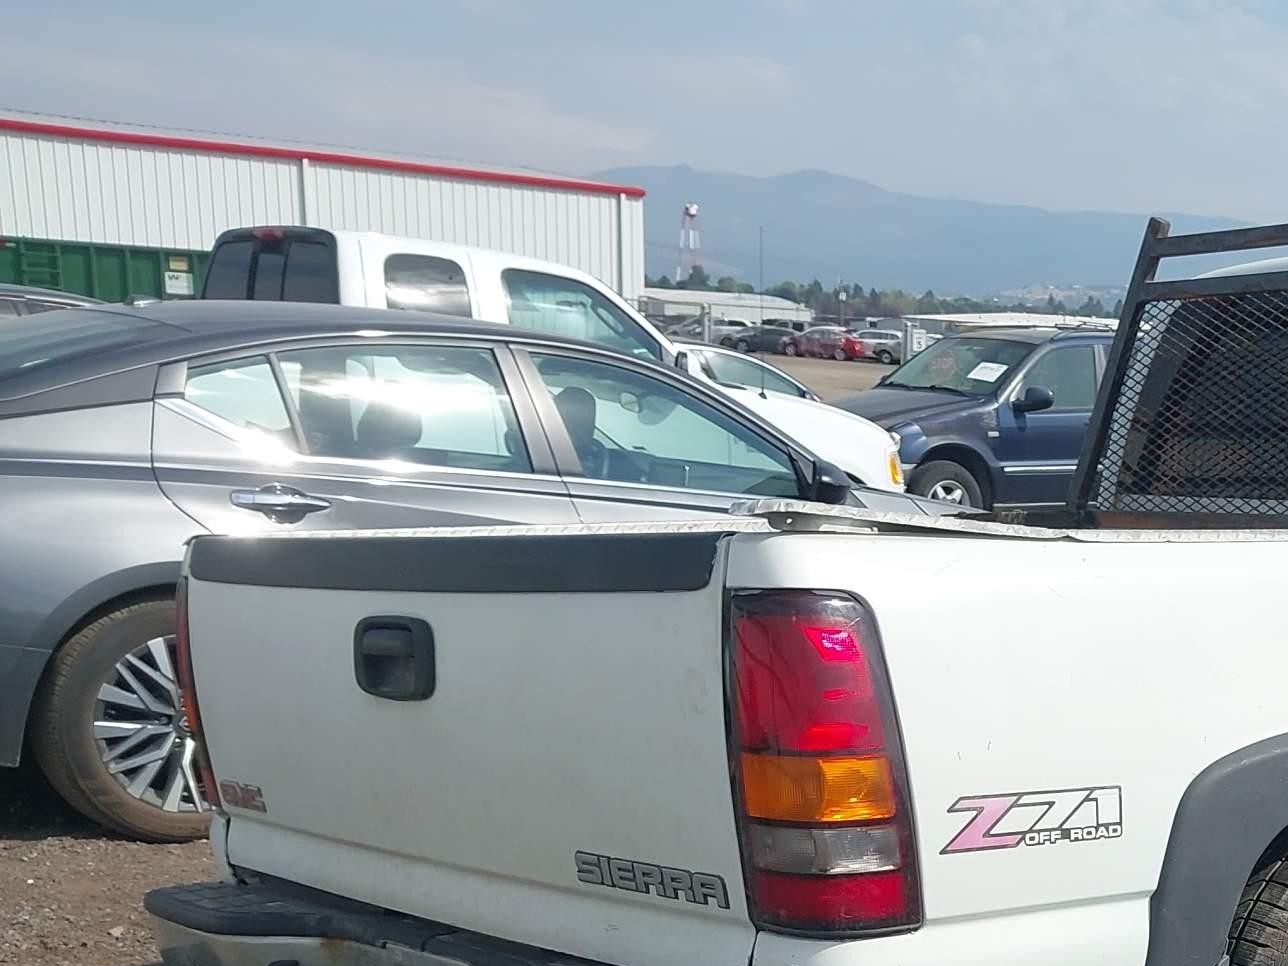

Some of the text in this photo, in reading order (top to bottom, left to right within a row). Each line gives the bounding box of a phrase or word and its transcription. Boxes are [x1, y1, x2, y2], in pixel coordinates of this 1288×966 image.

[939, 785, 1122, 855] Z71
[1025, 824, 1123, 845] OFF ROAD
[574, 850, 731, 909] SIERRA
